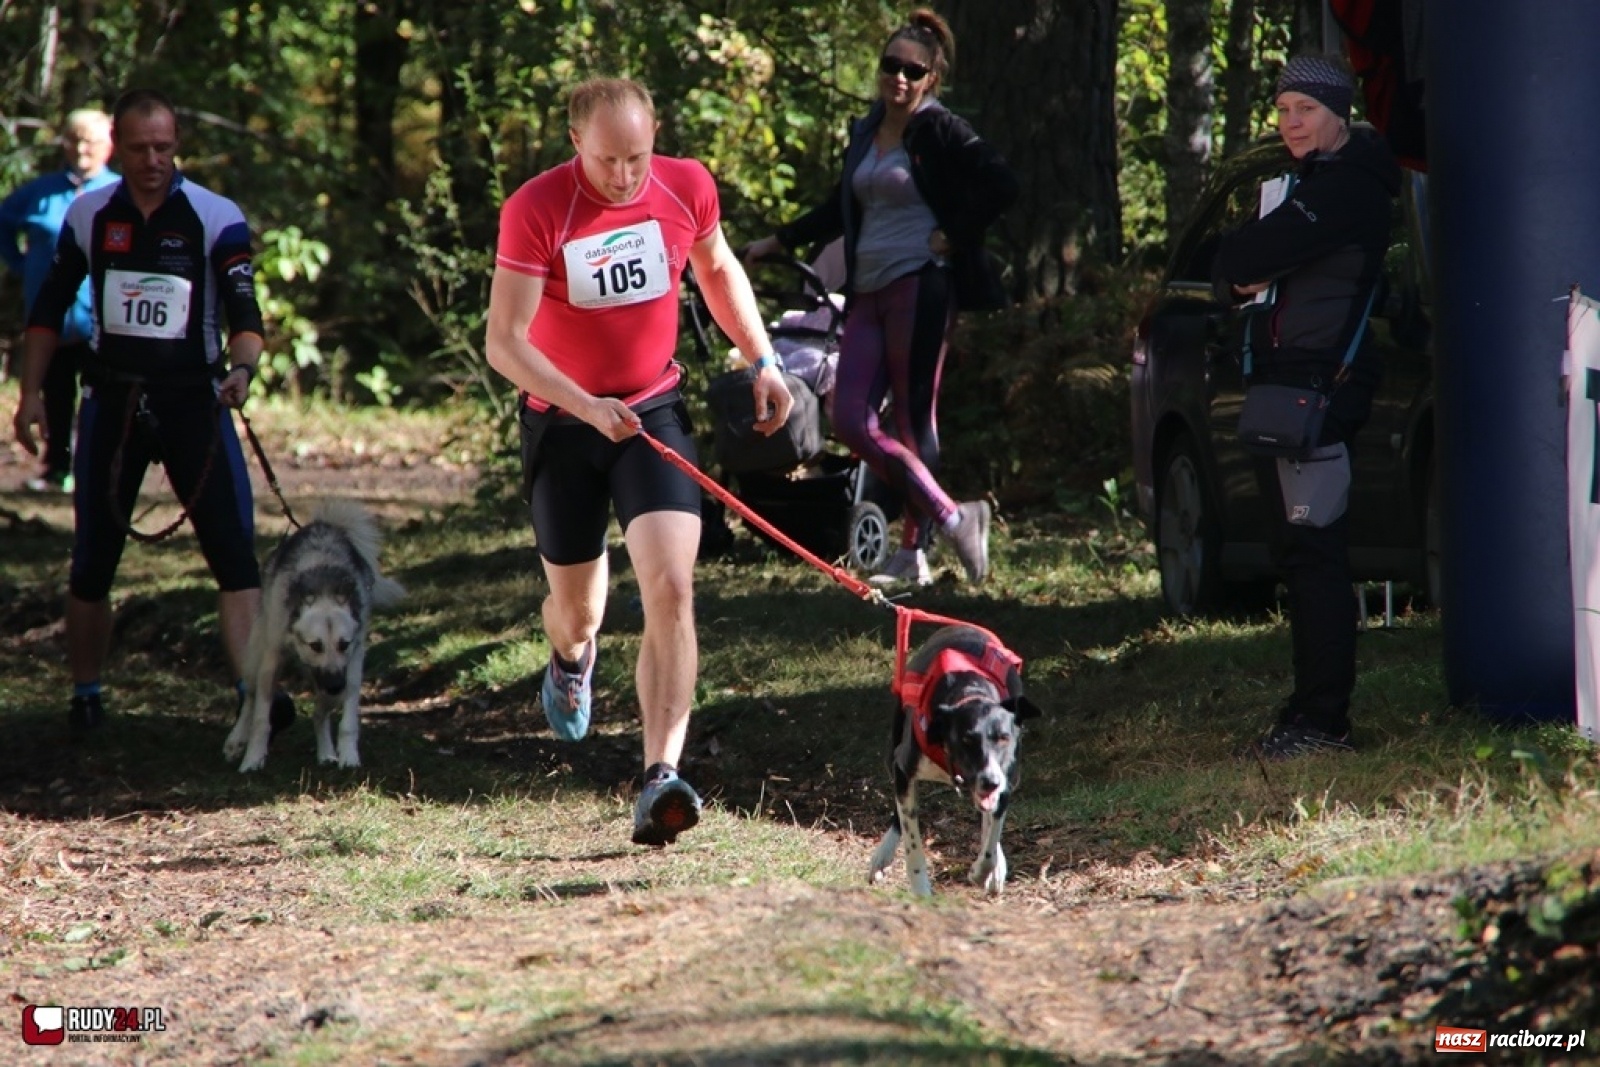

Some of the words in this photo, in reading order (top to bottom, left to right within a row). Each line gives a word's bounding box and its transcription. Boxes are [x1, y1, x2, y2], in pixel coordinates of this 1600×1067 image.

[584, 236, 646, 260] datasport.pl
[121, 281, 175, 295] datasport.pl
[591, 257, 647, 296] 105
[122, 299, 168, 327] 106
